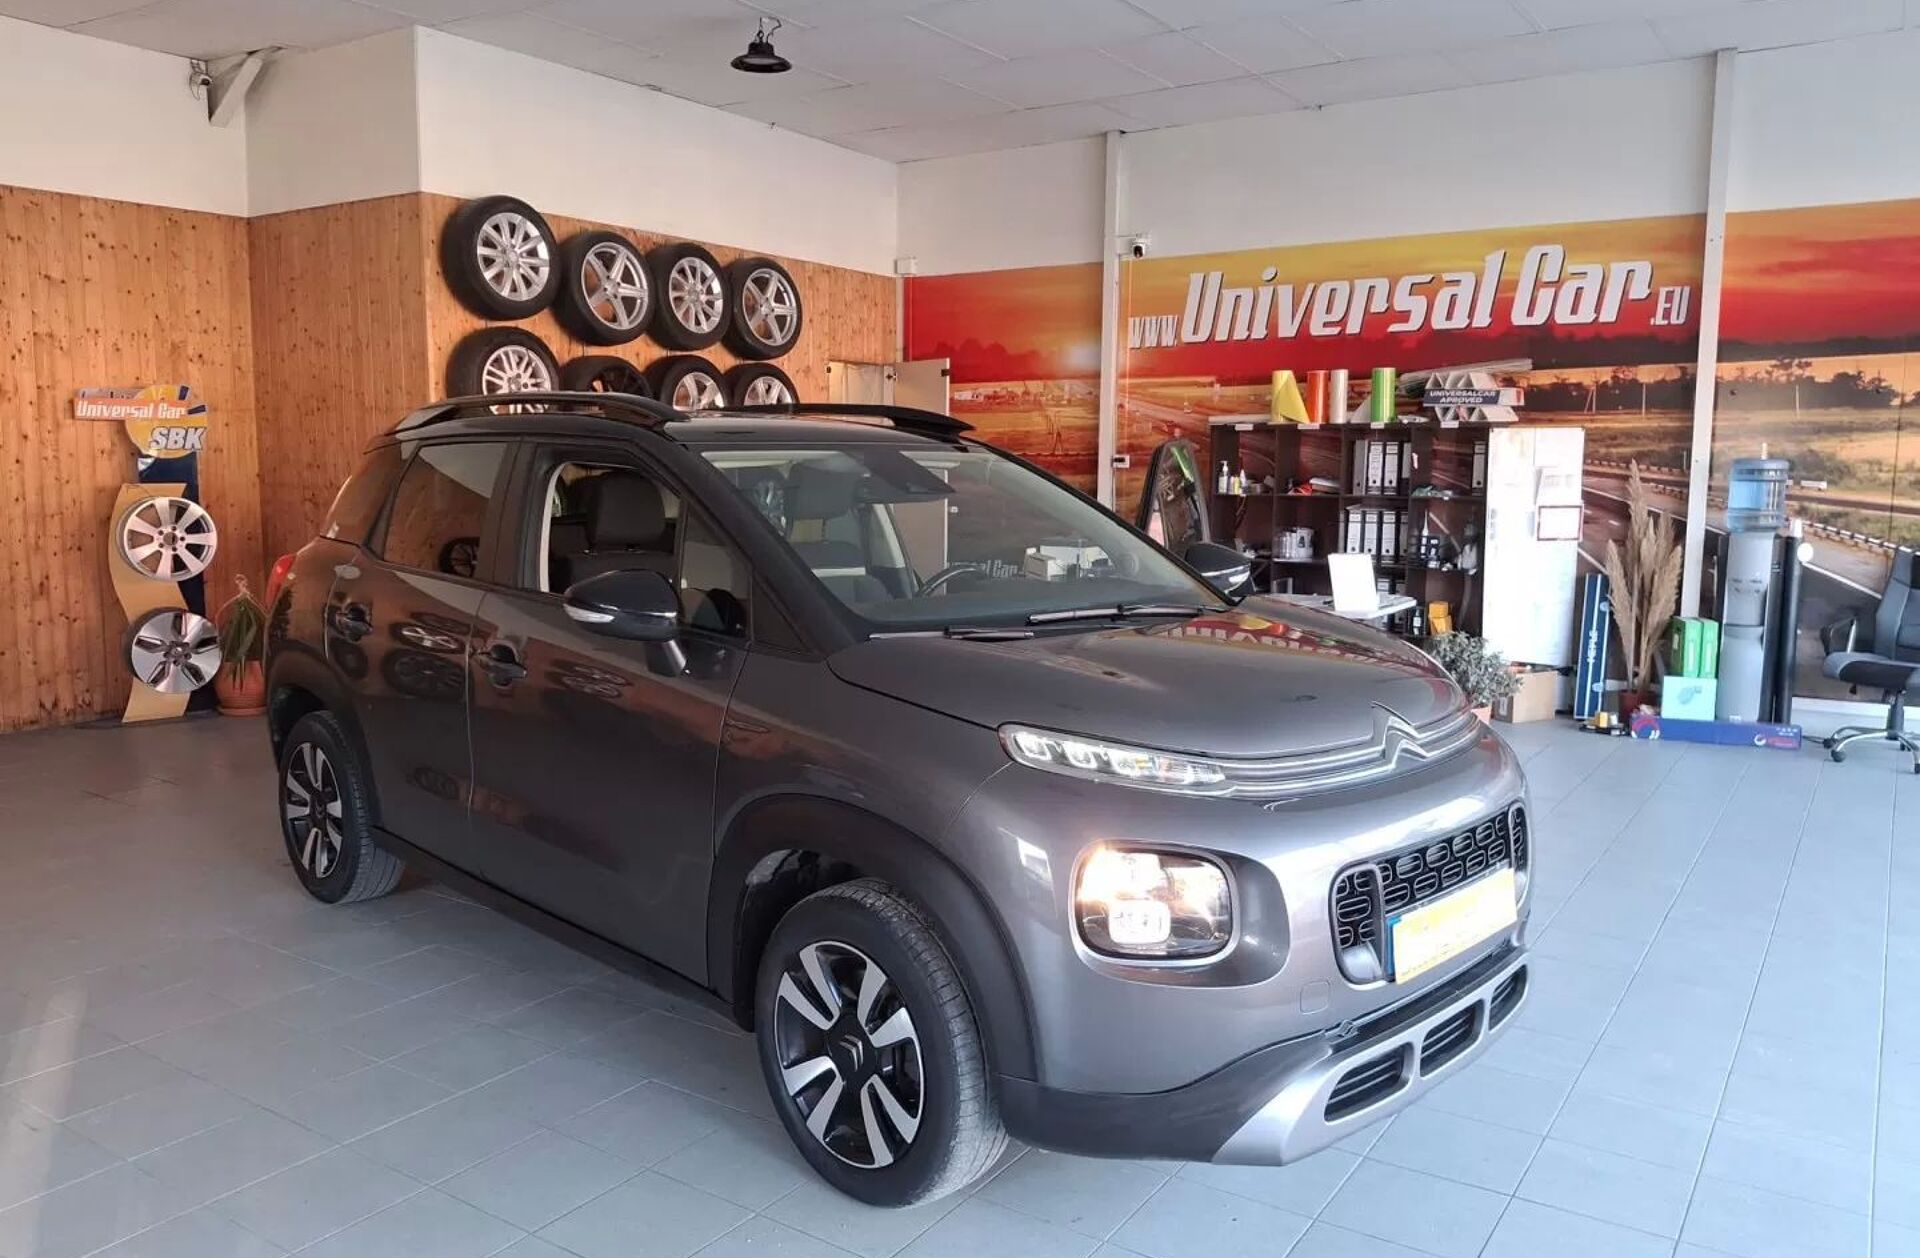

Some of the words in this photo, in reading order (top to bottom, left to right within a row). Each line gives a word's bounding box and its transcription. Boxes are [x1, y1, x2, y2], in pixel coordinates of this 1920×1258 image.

[76, 400, 154, 418] Universal
[157, 402, 188, 419] Car
[150, 427, 205, 450] SBK
